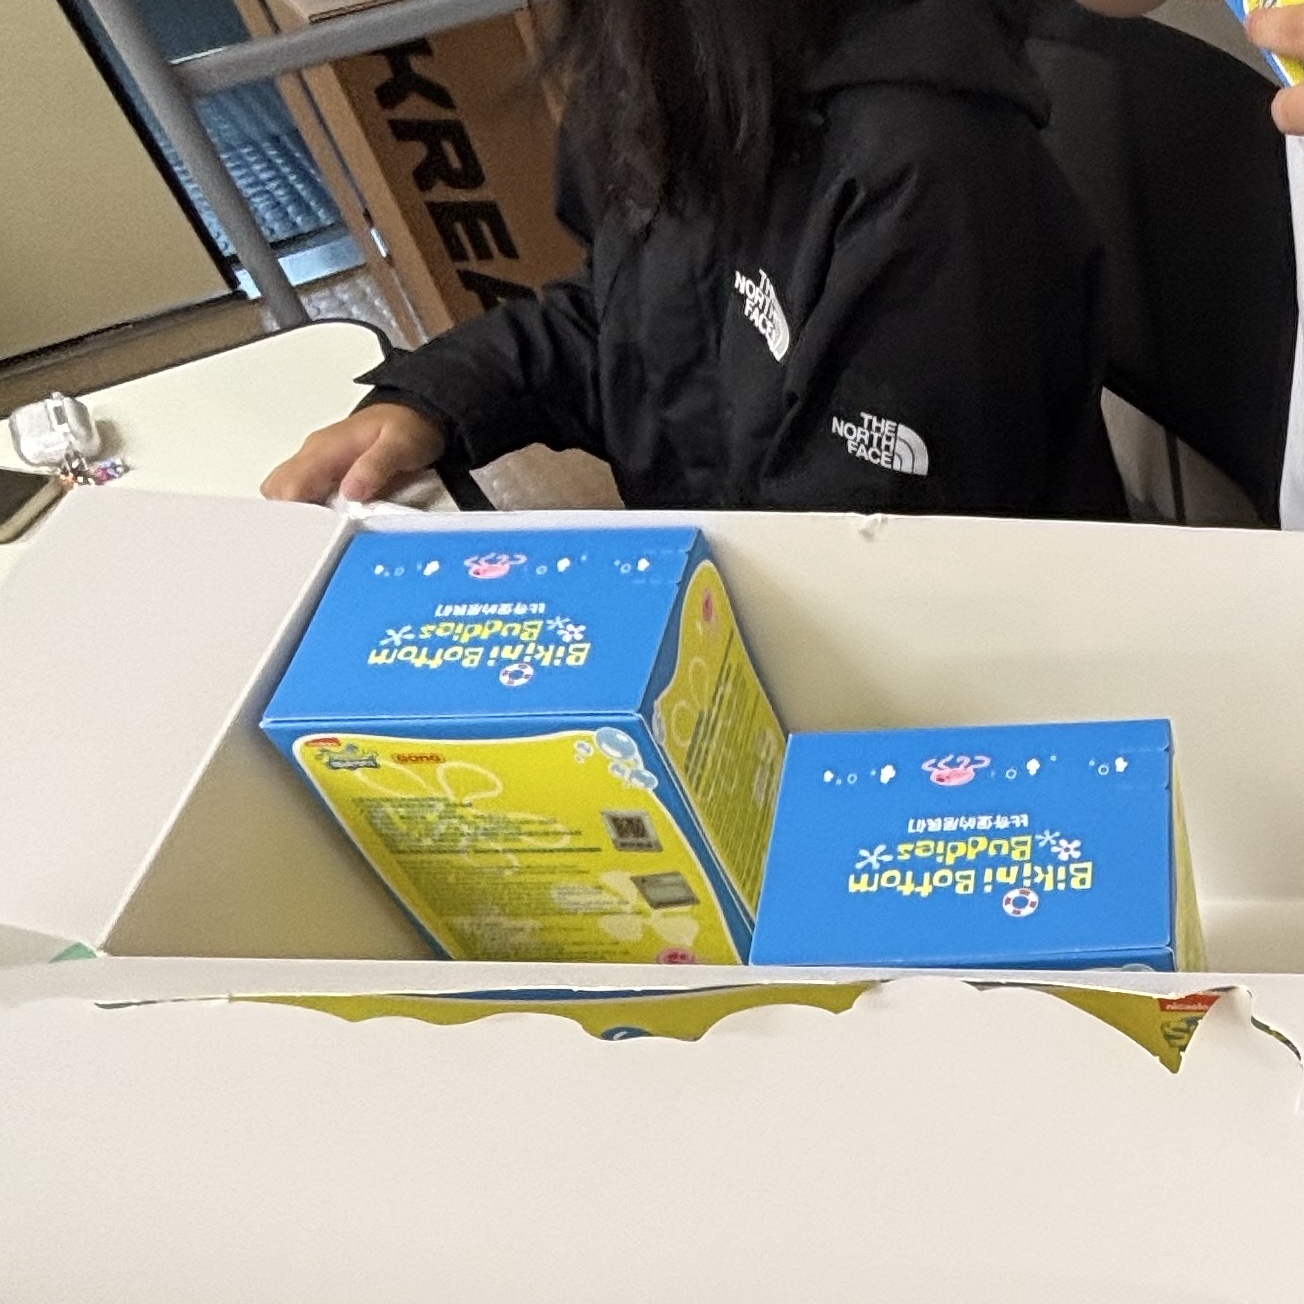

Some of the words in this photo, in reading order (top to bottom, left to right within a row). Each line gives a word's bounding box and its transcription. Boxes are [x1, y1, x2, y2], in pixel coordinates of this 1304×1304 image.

[734, 270, 778, 321] NORTH
[744, 298, 776, 352] FACE
[832, 416, 896, 454] NORTH
[860, 411, 897, 436] THE
[847, 439, 893, 469] FACE
[419, 619, 544, 643] Buddies
[367, 645, 485, 669] Bottom
[486, 643, 591, 667] Bikini
[896, 835, 1033, 865] Buddies
[848, 868, 976, 897] Bottom
[983, 861, 1093, 894] Bikini
